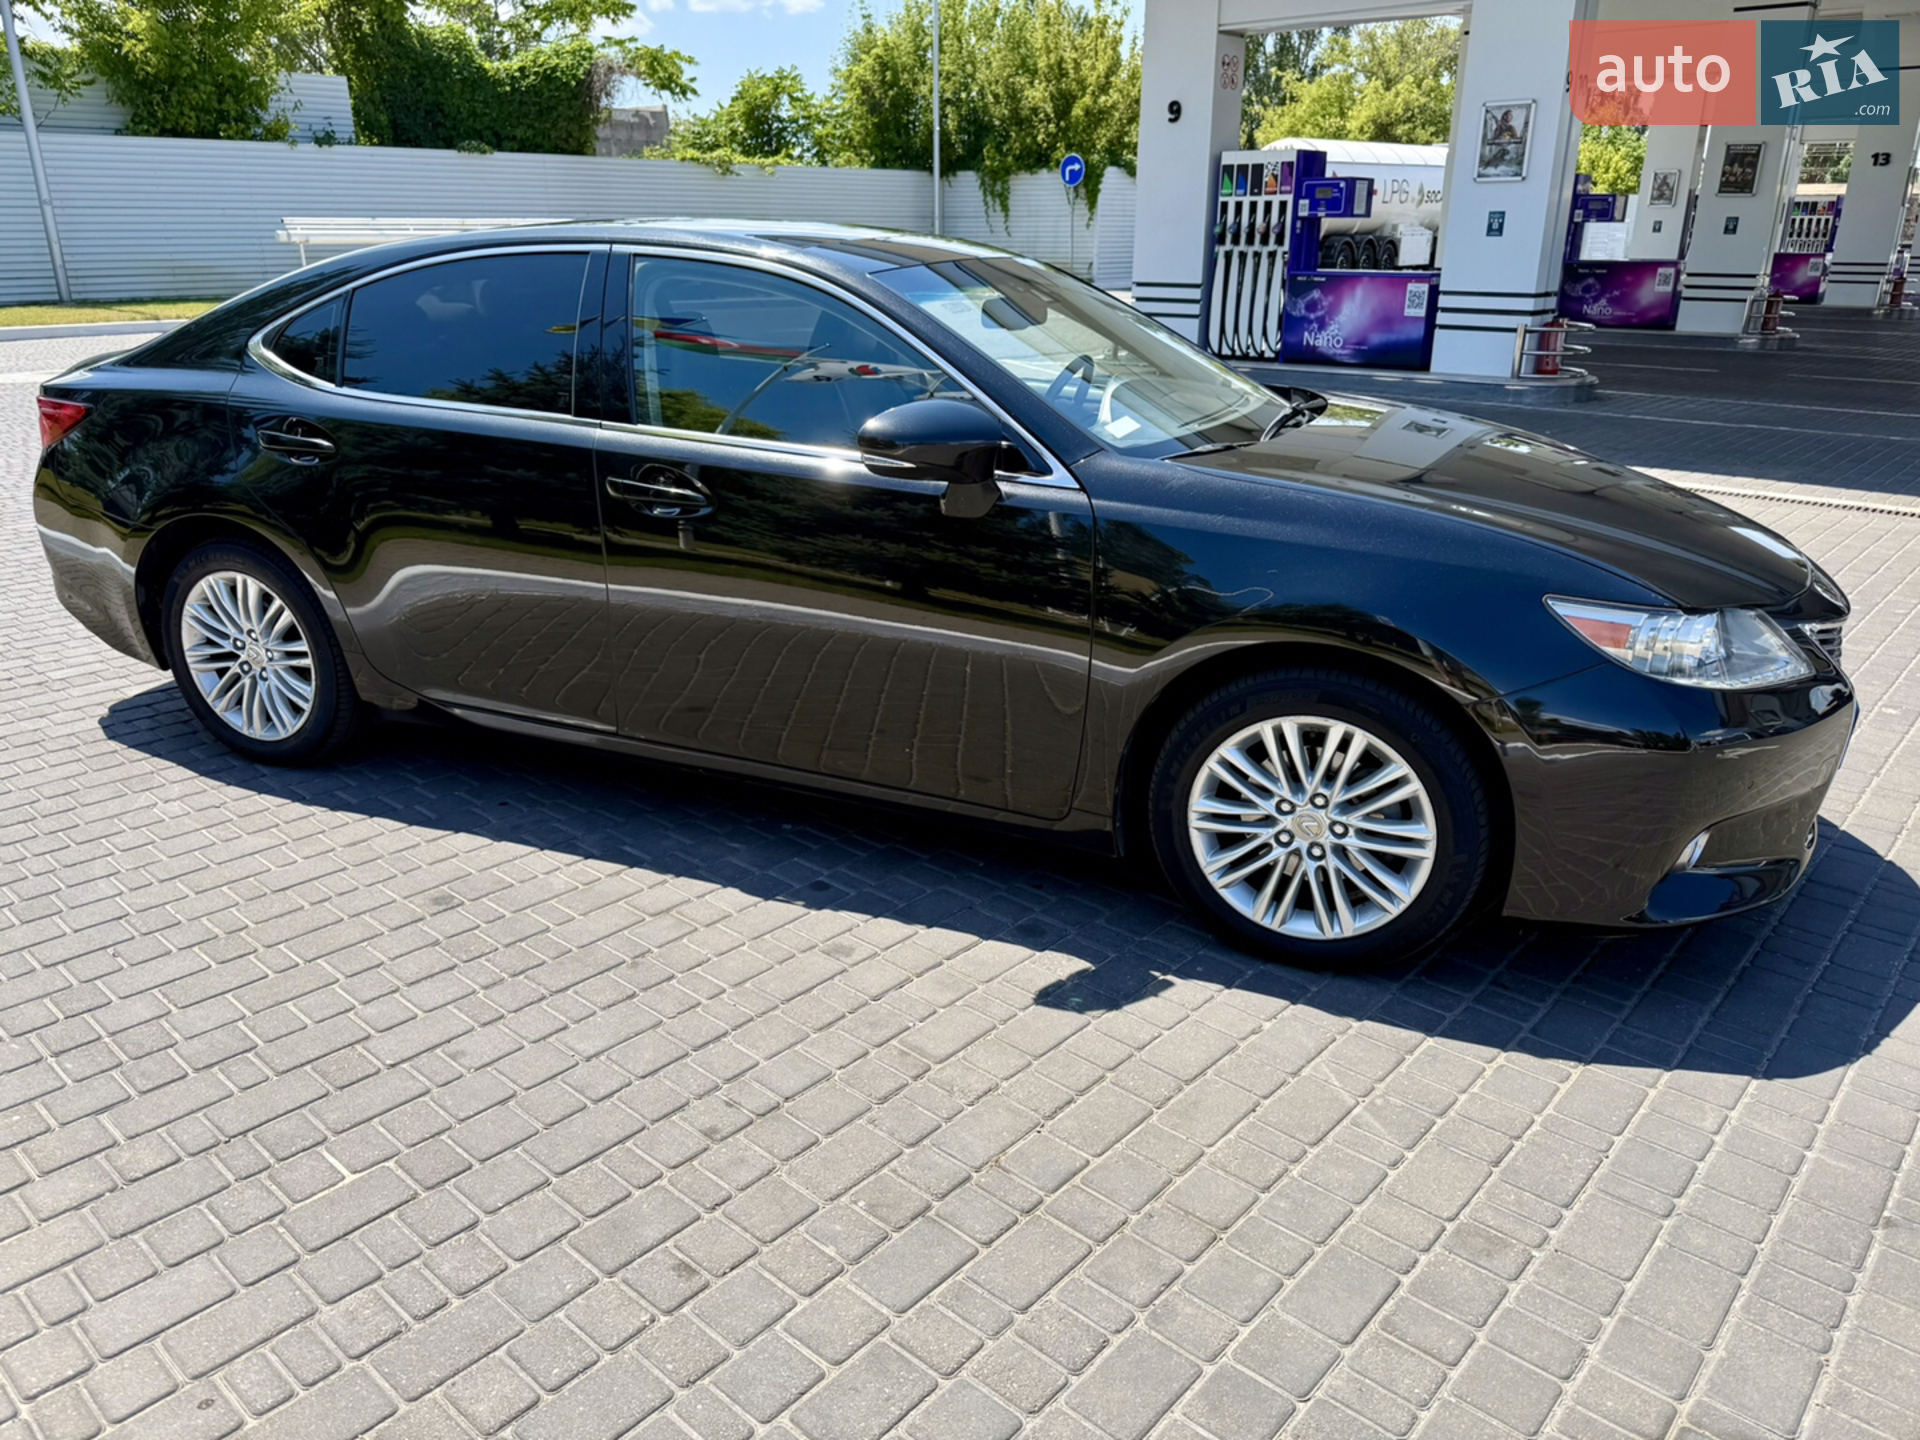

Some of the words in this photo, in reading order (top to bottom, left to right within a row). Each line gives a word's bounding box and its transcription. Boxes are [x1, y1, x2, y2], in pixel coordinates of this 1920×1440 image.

[1167, 100, 1182, 123] 9
[1871, 152, 1891, 167] 13
[1382, 179, 1410, 204] LPG
[1582, 304, 1612, 316] Nano
[1303, 331, 1343, 348] Nano
